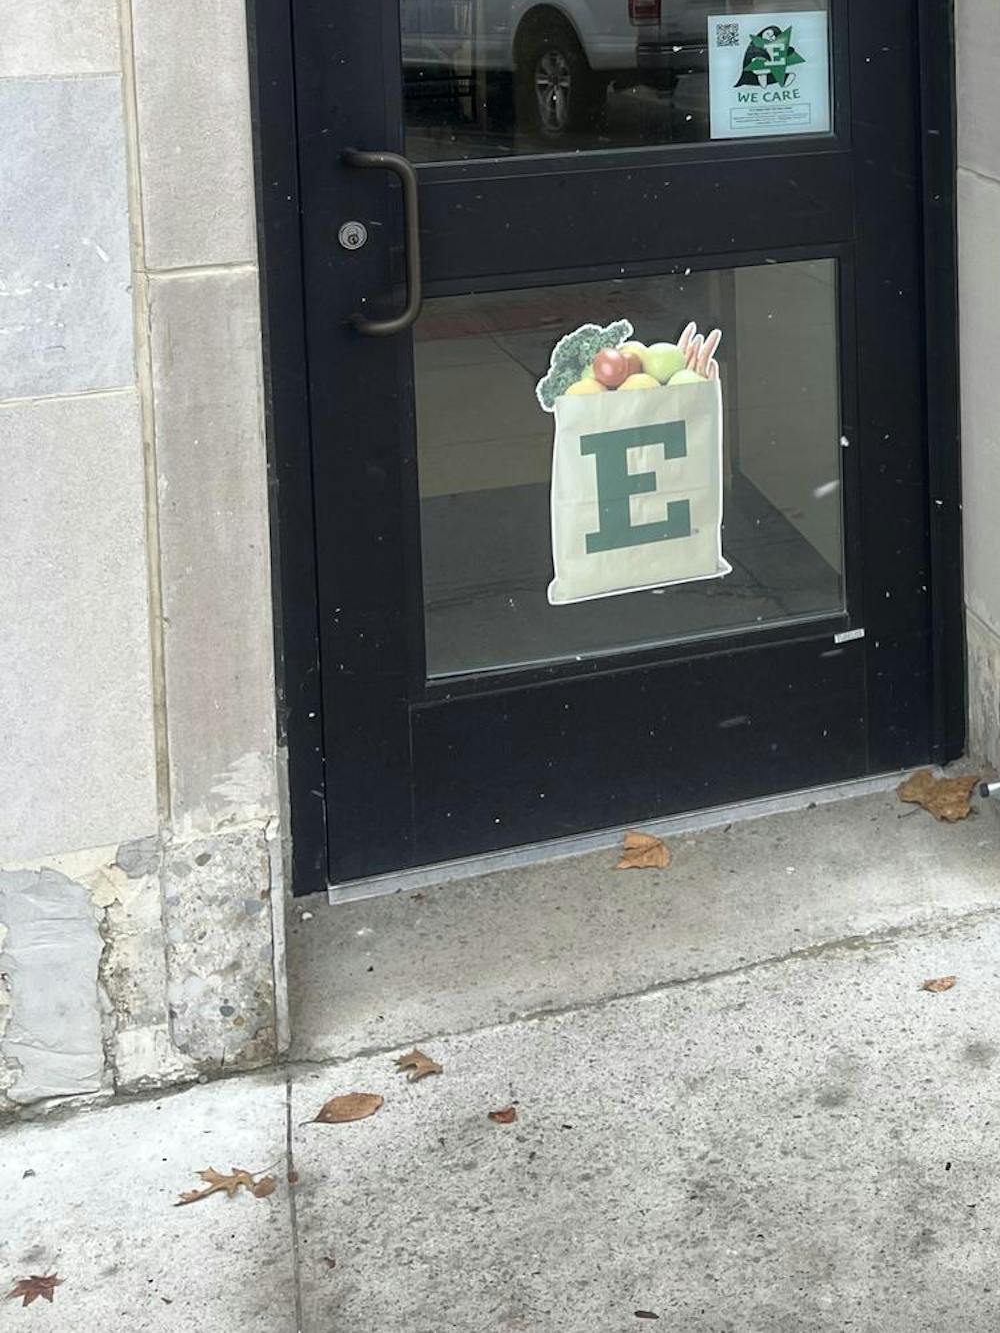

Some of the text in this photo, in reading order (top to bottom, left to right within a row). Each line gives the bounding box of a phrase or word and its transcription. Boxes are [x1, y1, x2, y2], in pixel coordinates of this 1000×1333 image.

[763, 44, 786, 66] E
[738, 89, 801, 103] WE CARE
[580, 420, 691, 554] E
